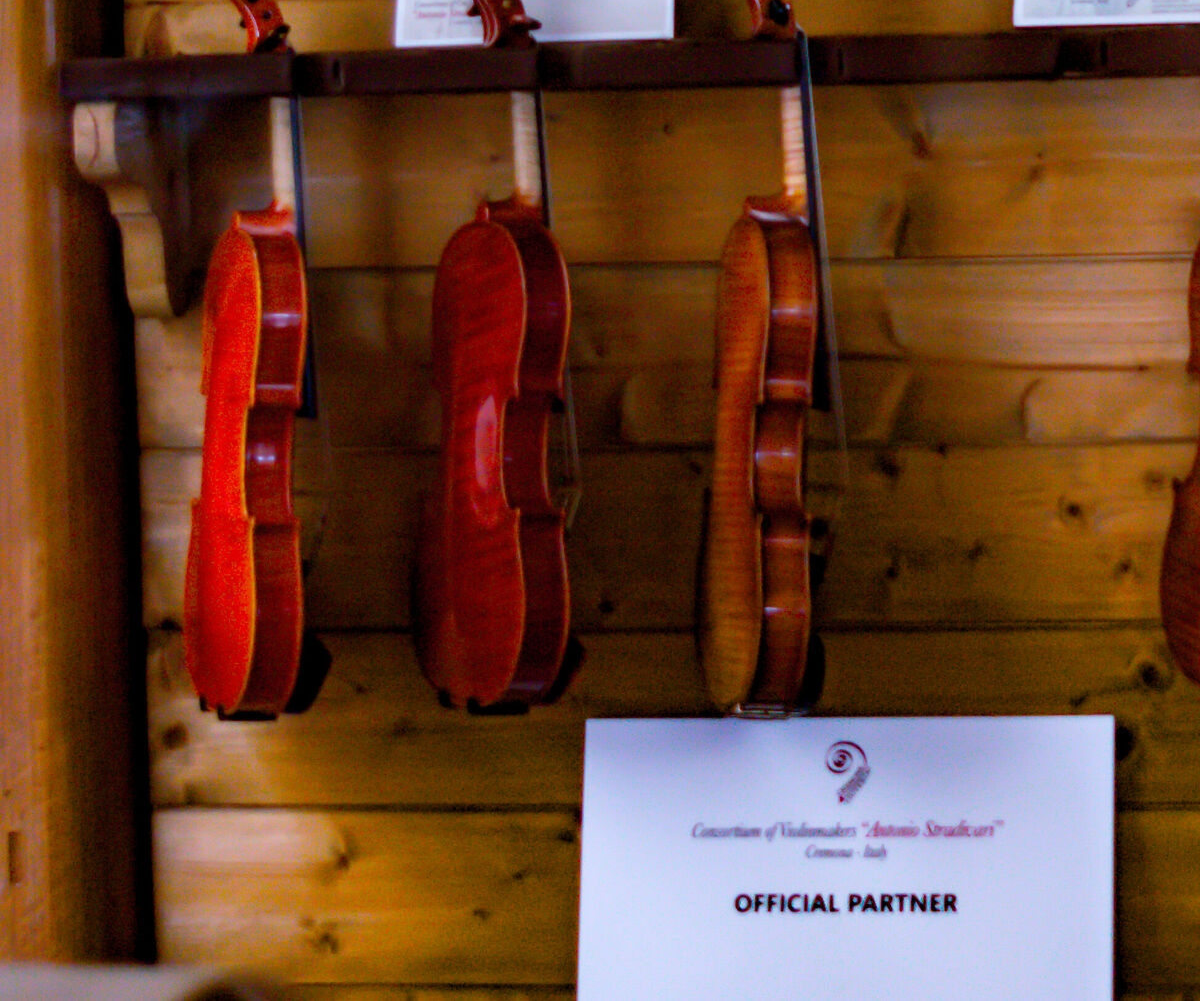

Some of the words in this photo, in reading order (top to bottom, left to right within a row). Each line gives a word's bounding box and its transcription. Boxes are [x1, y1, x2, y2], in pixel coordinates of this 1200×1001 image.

[690, 821, 761, 839] Consortium
[764, 821, 778, 841] of
[804, 843, 854, 859] Cremona
[862, 844, 887, 861] Italy
[734, 893, 839, 913] OFFICIAL
[849, 893, 958, 913] PARTNER
